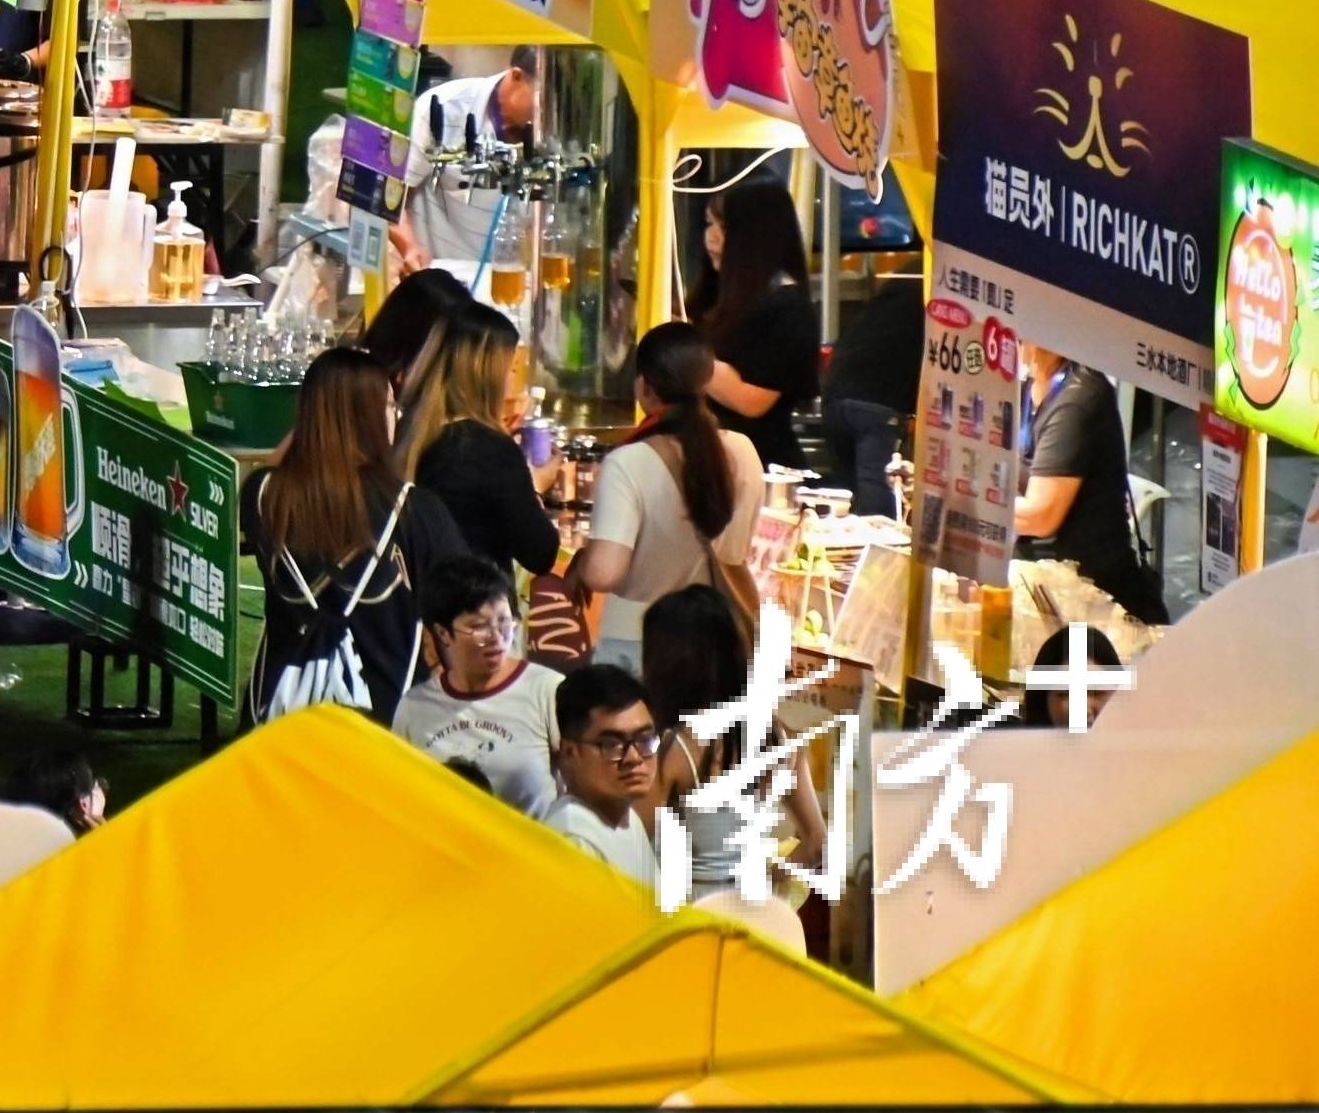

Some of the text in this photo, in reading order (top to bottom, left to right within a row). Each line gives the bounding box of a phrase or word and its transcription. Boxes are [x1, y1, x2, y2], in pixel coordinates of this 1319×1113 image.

[985, 156, 1054, 237] 猫员外
[929, 332, 962, 374] ¥66
[97, 446, 166, 510] Heineken
[190, 501, 219, 540] SILVER
